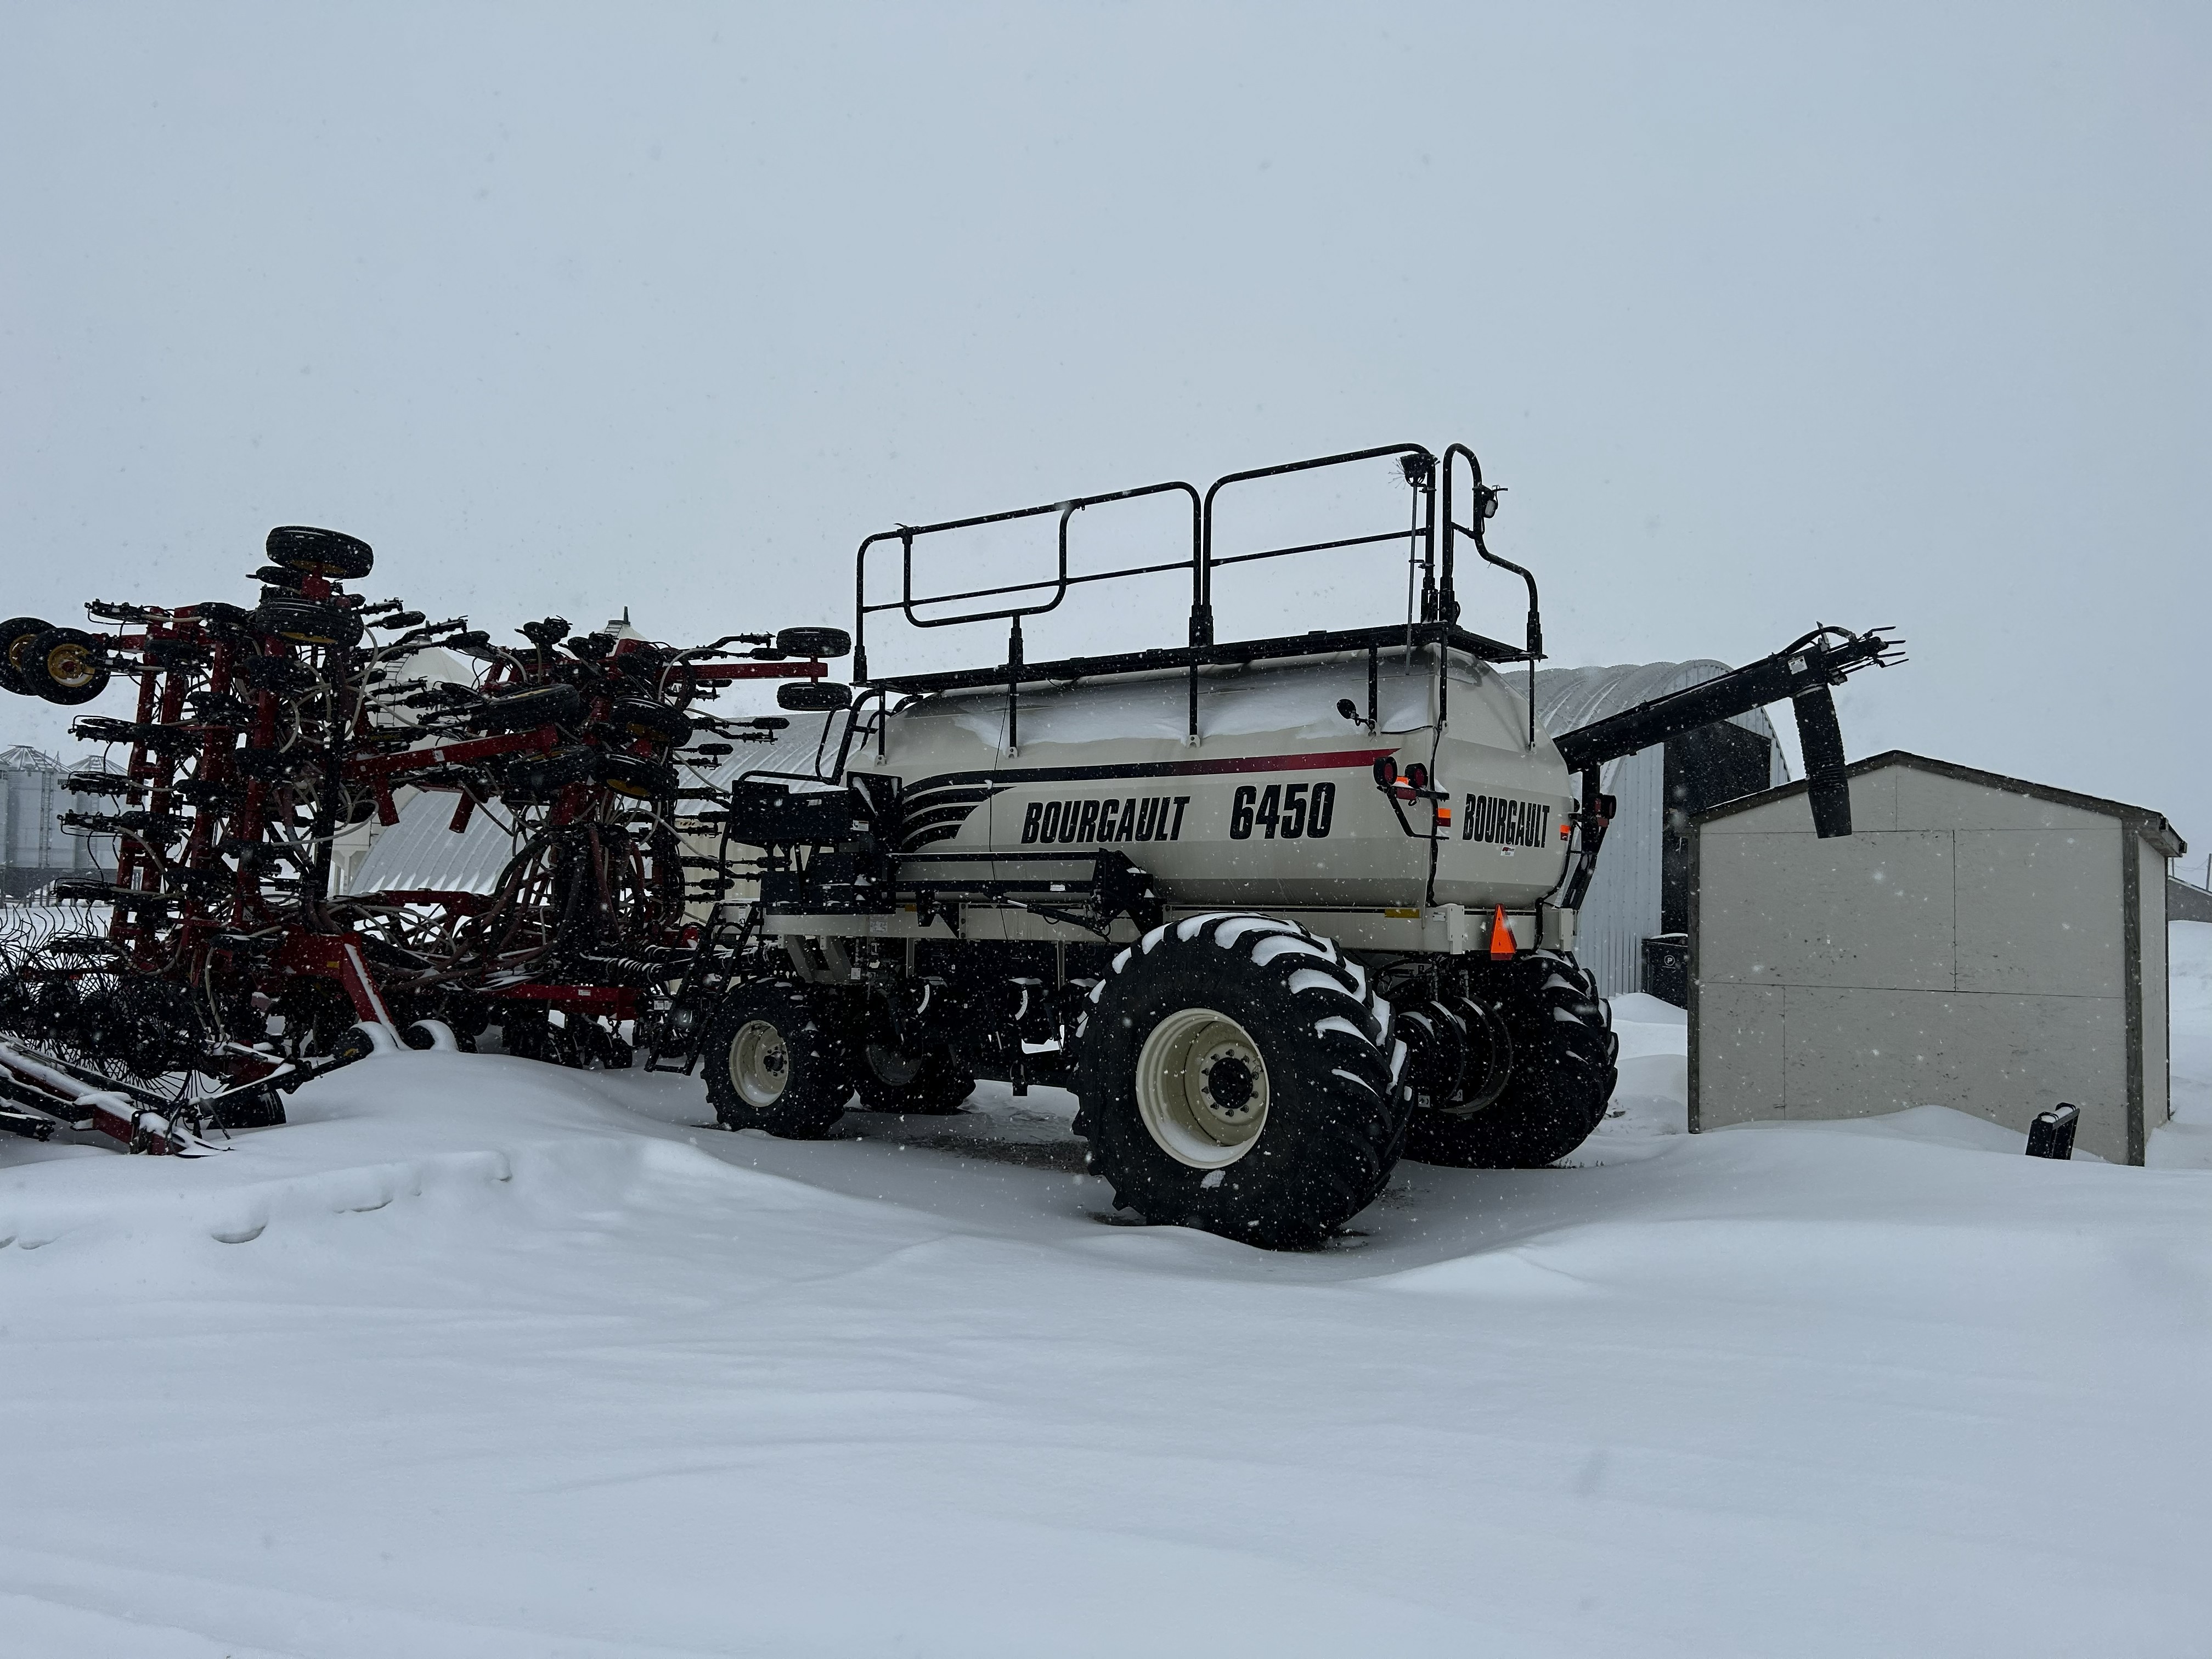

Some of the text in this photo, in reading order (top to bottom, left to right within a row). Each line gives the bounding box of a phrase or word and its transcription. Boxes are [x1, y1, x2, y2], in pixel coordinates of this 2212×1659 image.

[1021, 782, 1336, 844] BOURGAULT 6450
[1463, 793, 1550, 848] BOURGAULT
